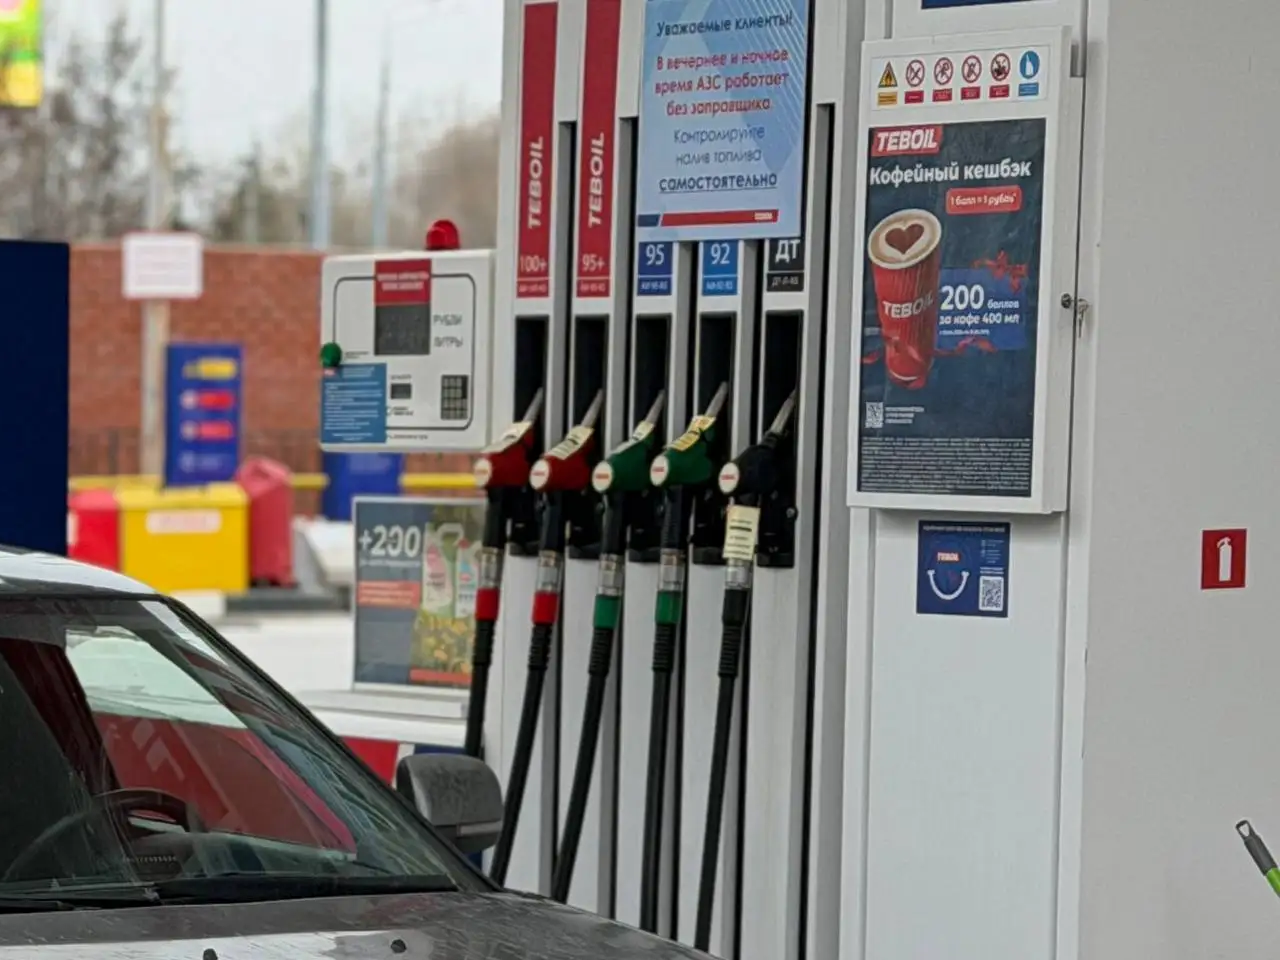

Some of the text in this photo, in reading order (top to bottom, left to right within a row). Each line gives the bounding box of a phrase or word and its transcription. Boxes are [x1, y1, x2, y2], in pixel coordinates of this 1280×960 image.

[656, 10, 793, 37] Уважаемые клиенты!
[656, 50, 789, 70] В вечернее и ночное
[655, 72, 790, 95] время АЗС работает
[666, 98, 771, 117] без заправщика
[673, 123, 766, 145] Контролируйте
[877, 129, 938, 152] TEBOIL
[676, 149, 763, 165] налив топлива
[527, 136, 545, 228] TEBOIL
[587, 133, 605, 228] TEBOIL
[659, 173, 778, 192] самостоятельно
[870, 157, 1032, 188] Кофейный кешбэк
[645, 244, 665, 265] 95
[710, 243, 730, 265] 92
[774, 239, 801, 263] ДТ
[520, 254, 547, 273] 100+
[582, 254, 605, 271] 95+
[882, 291, 934, 319] TEBOIL
[940, 284, 1020, 310] 200 баллов
[939, 312, 1020, 328] за кофе 400 мл
[358, 524, 421, 557] +200
